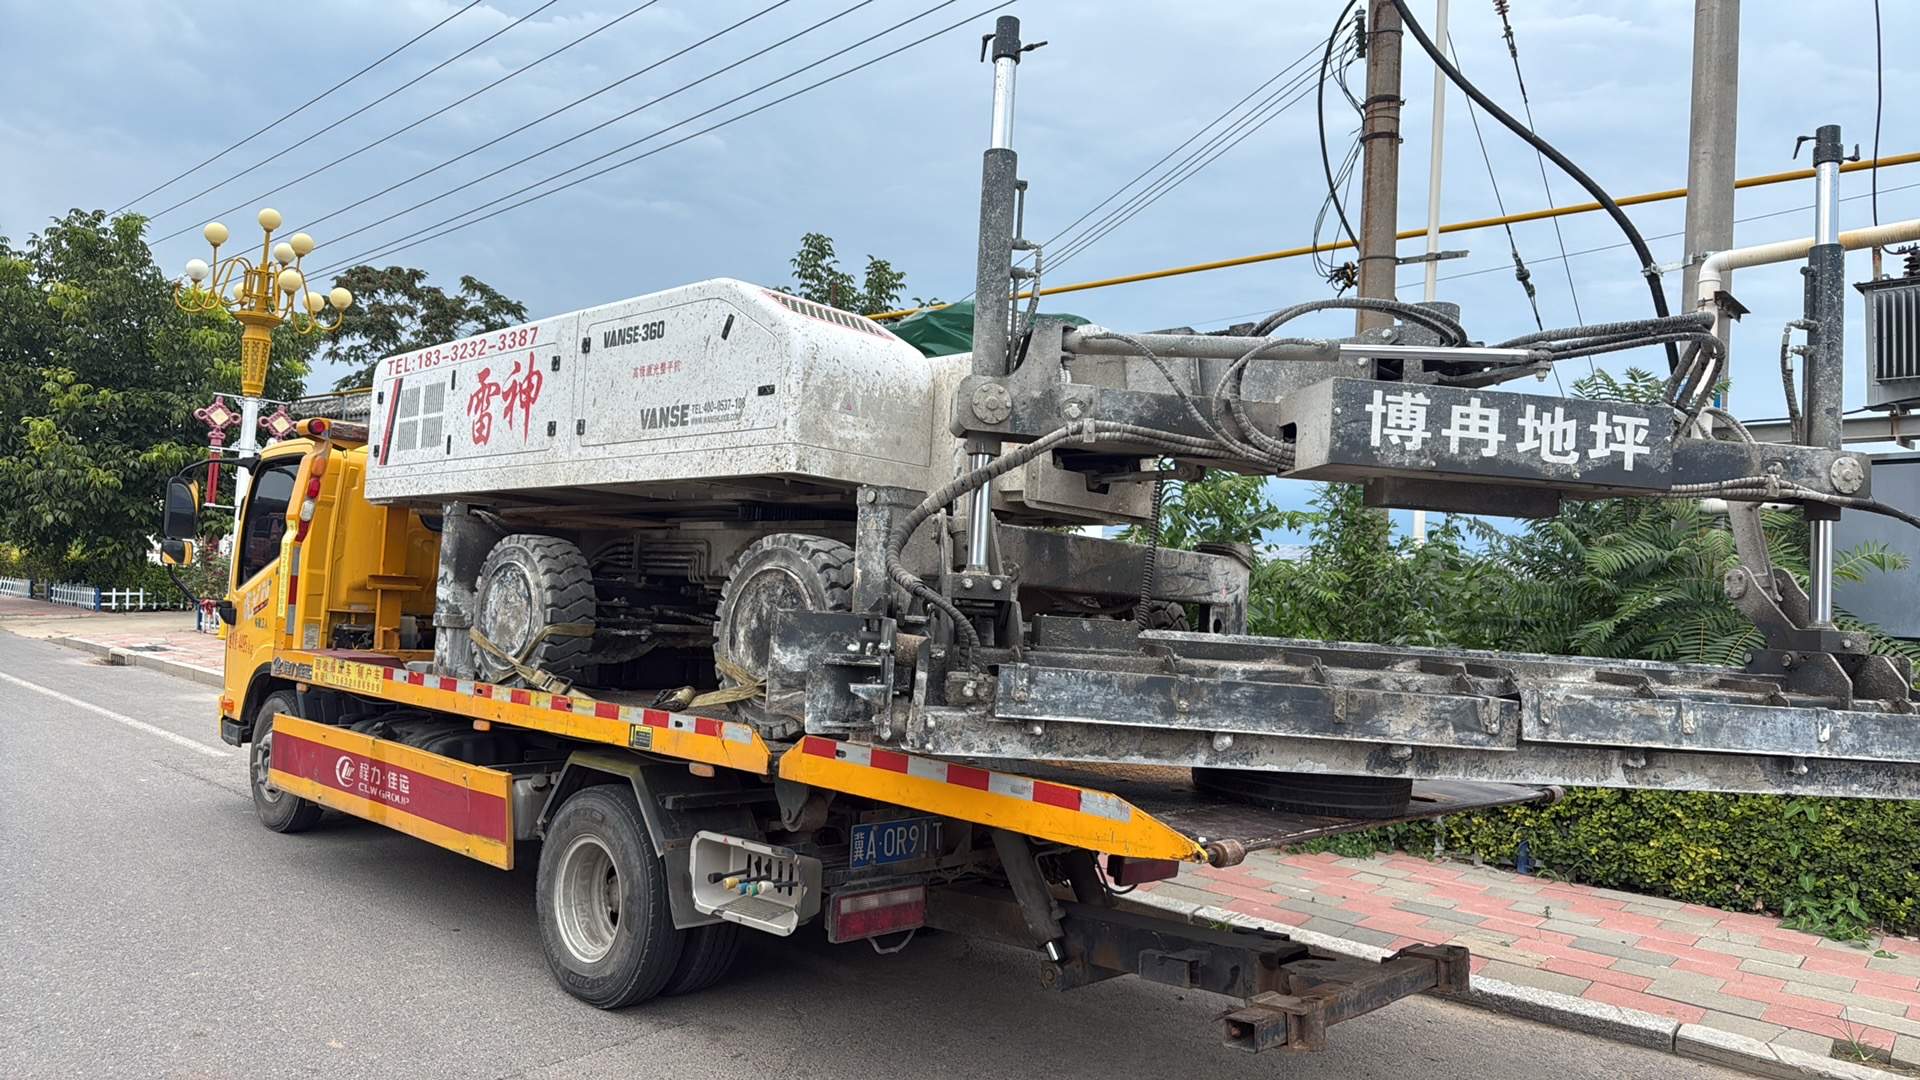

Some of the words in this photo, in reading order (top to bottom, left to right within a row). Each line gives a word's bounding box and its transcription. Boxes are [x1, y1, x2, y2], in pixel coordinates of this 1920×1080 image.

[387, 326, 539, 376] TEL:183-3232-3387
[467, 351, 543, 446] 雷神
[640, 404, 690, 430] VANSE
[1365, 390, 1651, 472] 博冉地坪
[358, 782, 378, 796] CLW
[379, 789, 410, 805] GROUP
